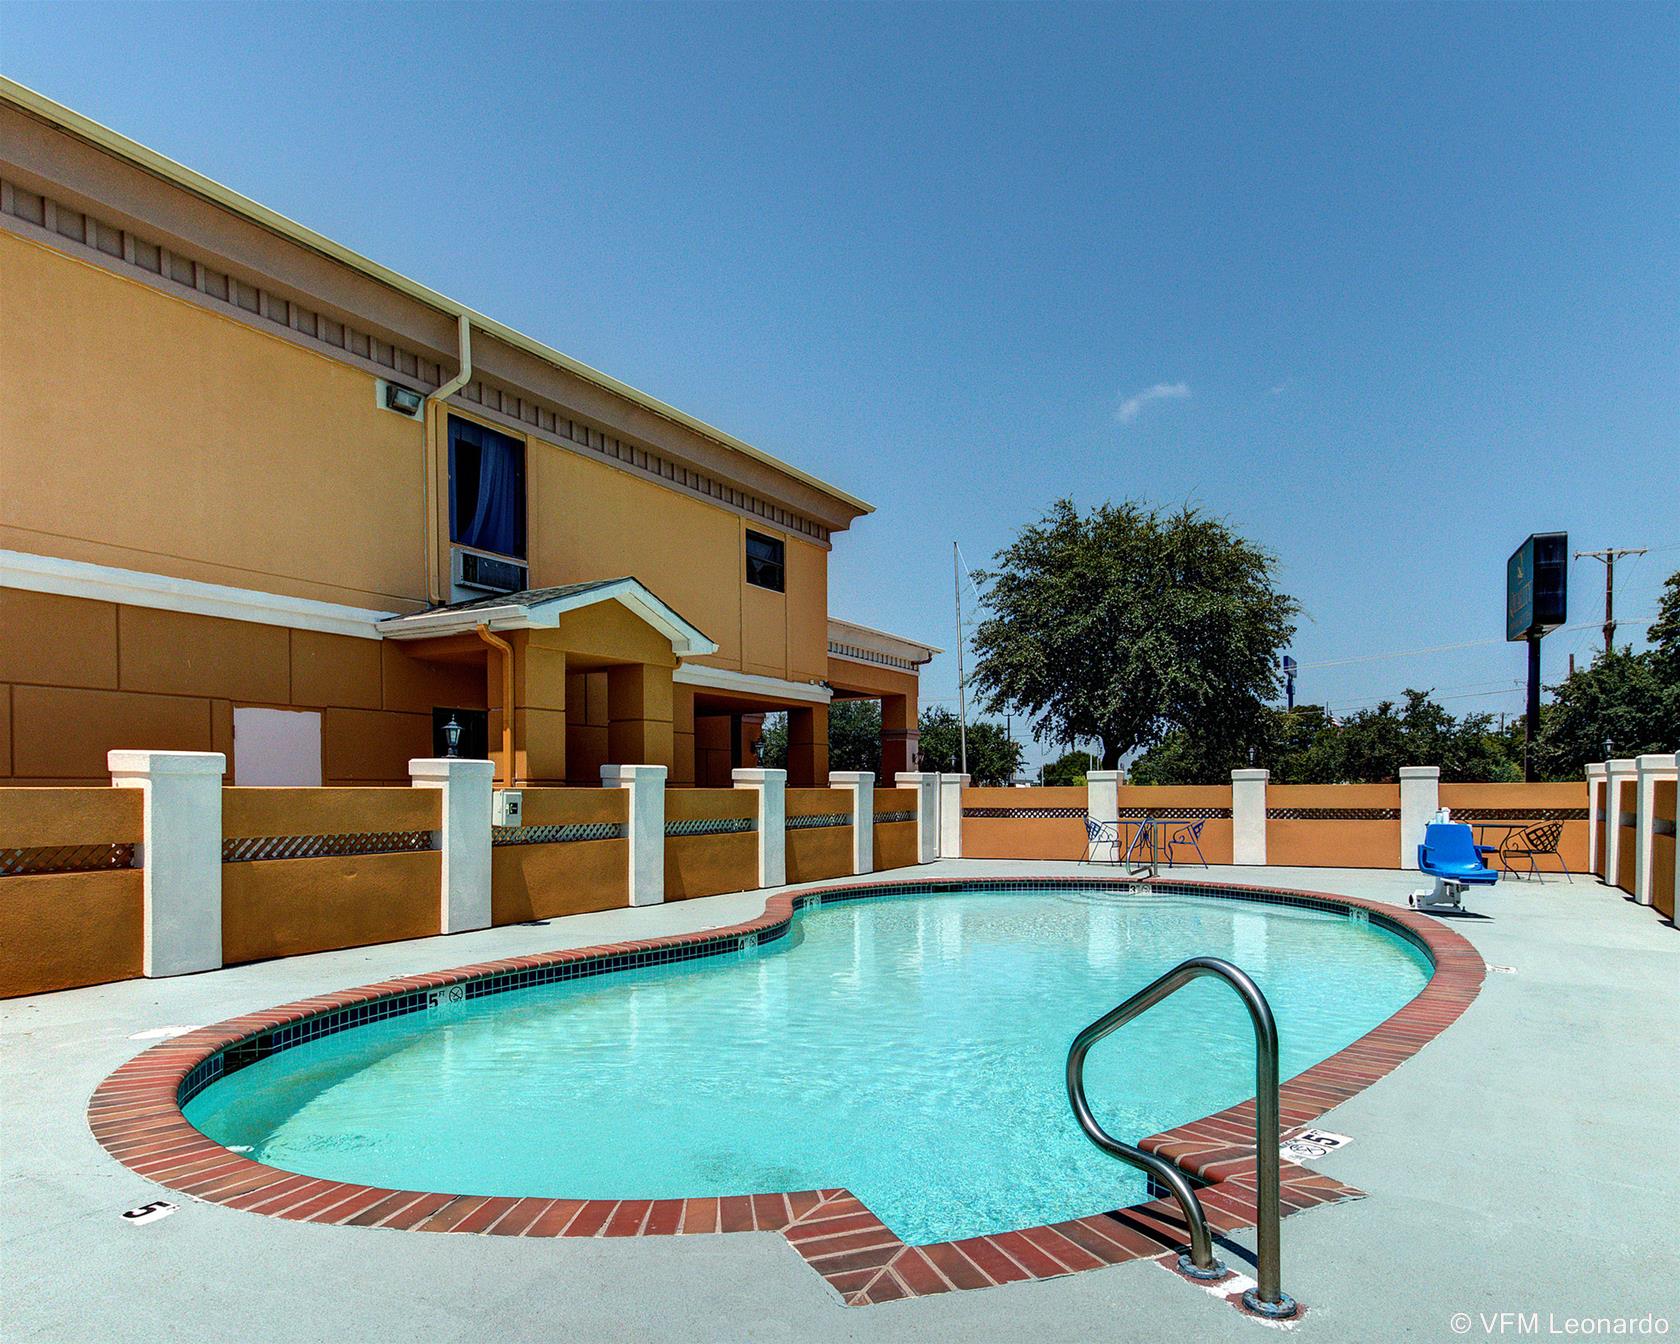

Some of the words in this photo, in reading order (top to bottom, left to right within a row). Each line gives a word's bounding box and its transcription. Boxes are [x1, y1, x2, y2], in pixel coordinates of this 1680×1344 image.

[429, 992, 439, 1008] 5
[1302, 1134, 1340, 1146] 5
[122, 1200, 171, 1219] 5
